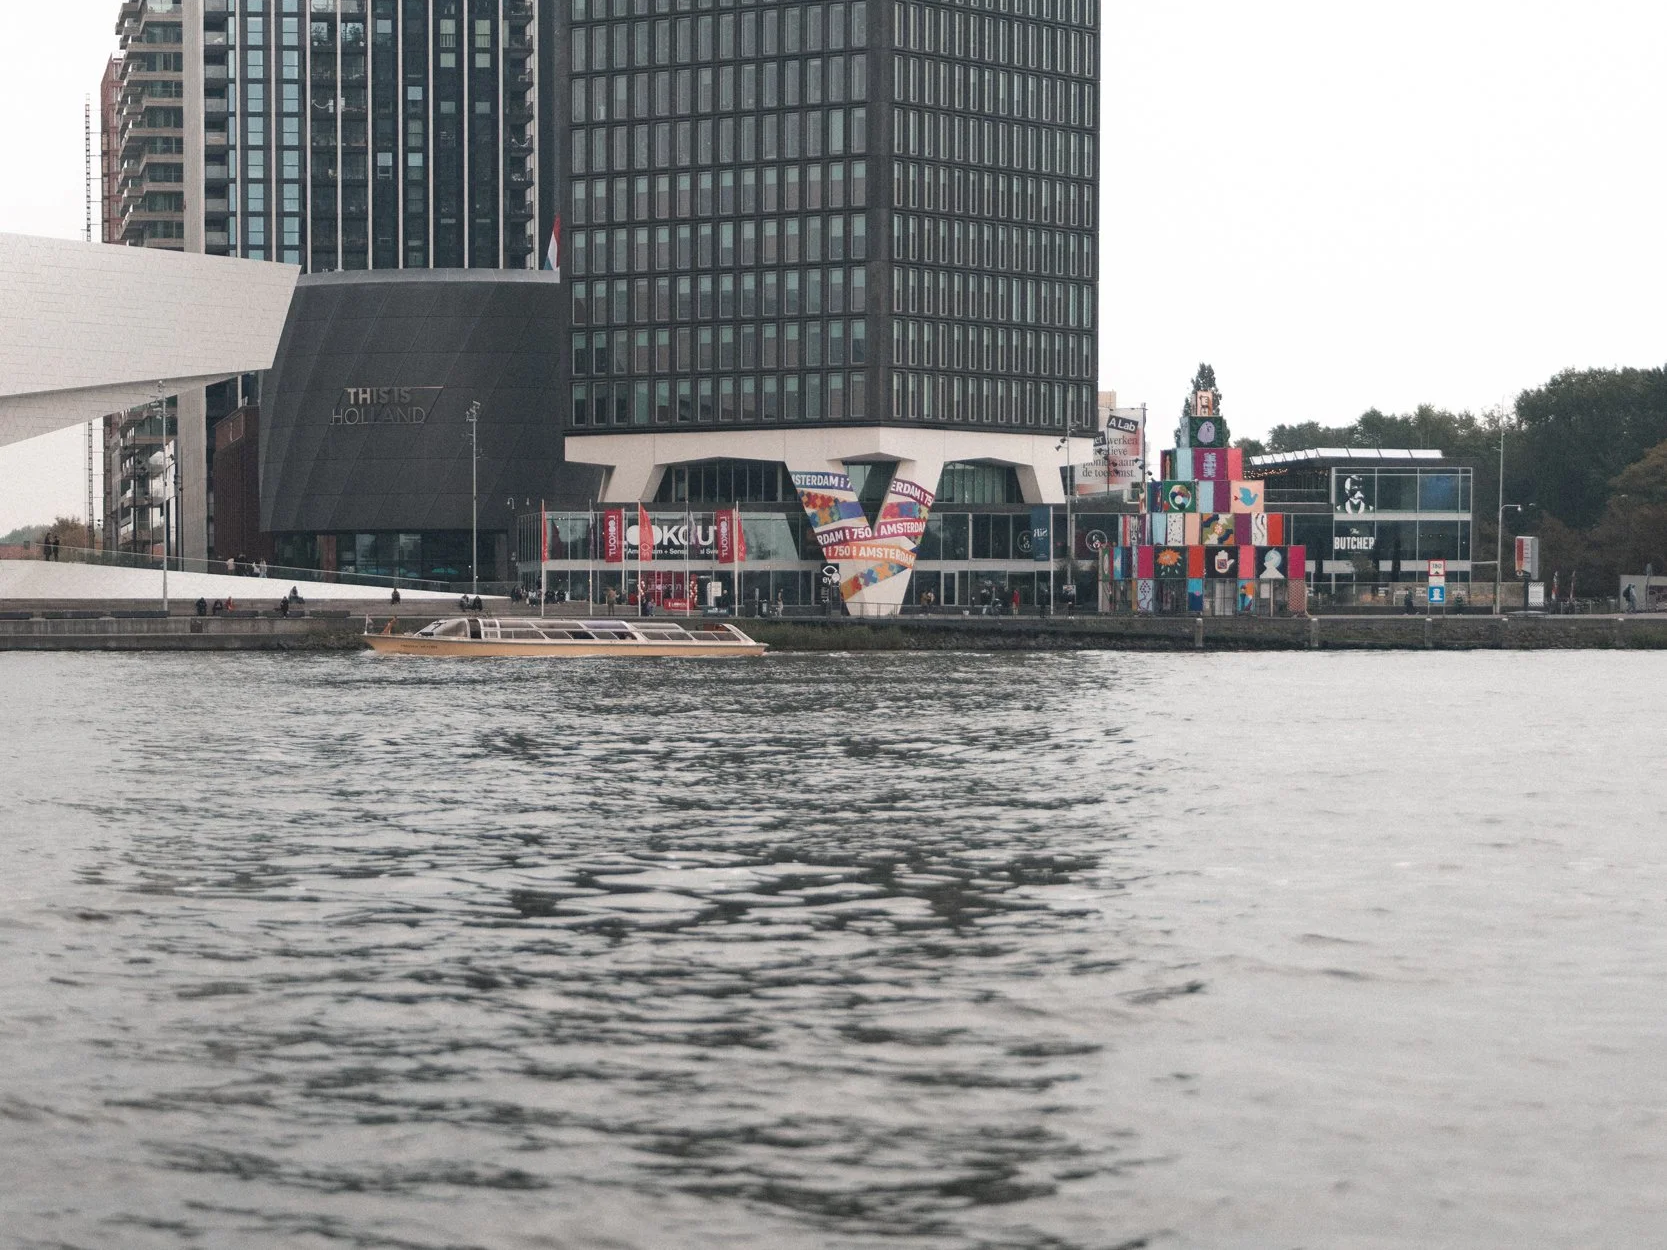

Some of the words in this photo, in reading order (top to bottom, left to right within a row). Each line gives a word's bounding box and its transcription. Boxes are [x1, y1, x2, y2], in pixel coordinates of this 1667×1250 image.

[347, 388, 390, 404] THIS
[394, 387, 411, 403] IS
[332, 407, 426, 424] HOLLAND
[1109, 417, 1116, 427] A
[1118, 419, 1136, 431] Lab
[1082, 468, 1092, 477] de
[852, 527, 872, 539] 750
[1334, 537, 1374, 550] BUTCHER
[833, 546, 850, 556] 750
[859, 547, 915, 567] AMSTERDAM
